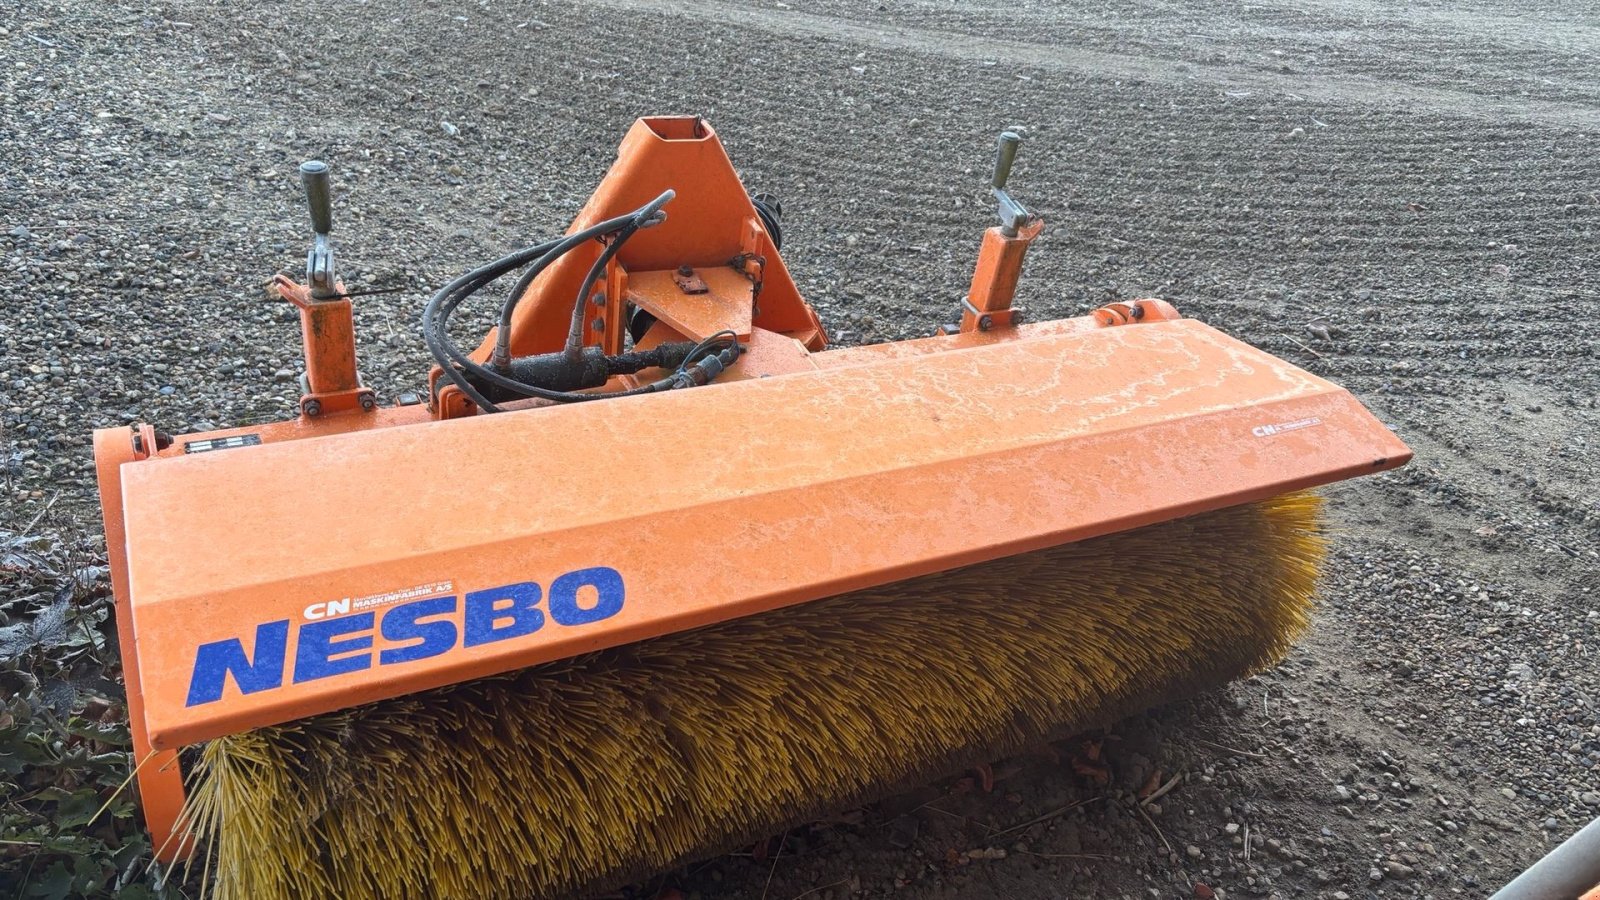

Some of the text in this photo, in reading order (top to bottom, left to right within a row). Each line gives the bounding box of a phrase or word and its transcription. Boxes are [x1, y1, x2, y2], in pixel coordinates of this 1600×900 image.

[1252, 424, 1277, 437] CN
[303, 597, 351, 620] CN
[352, 588, 433, 608] MASKINFABRIK
[436, 583, 453, 592] A/S
[185, 566, 626, 707] NESBO
